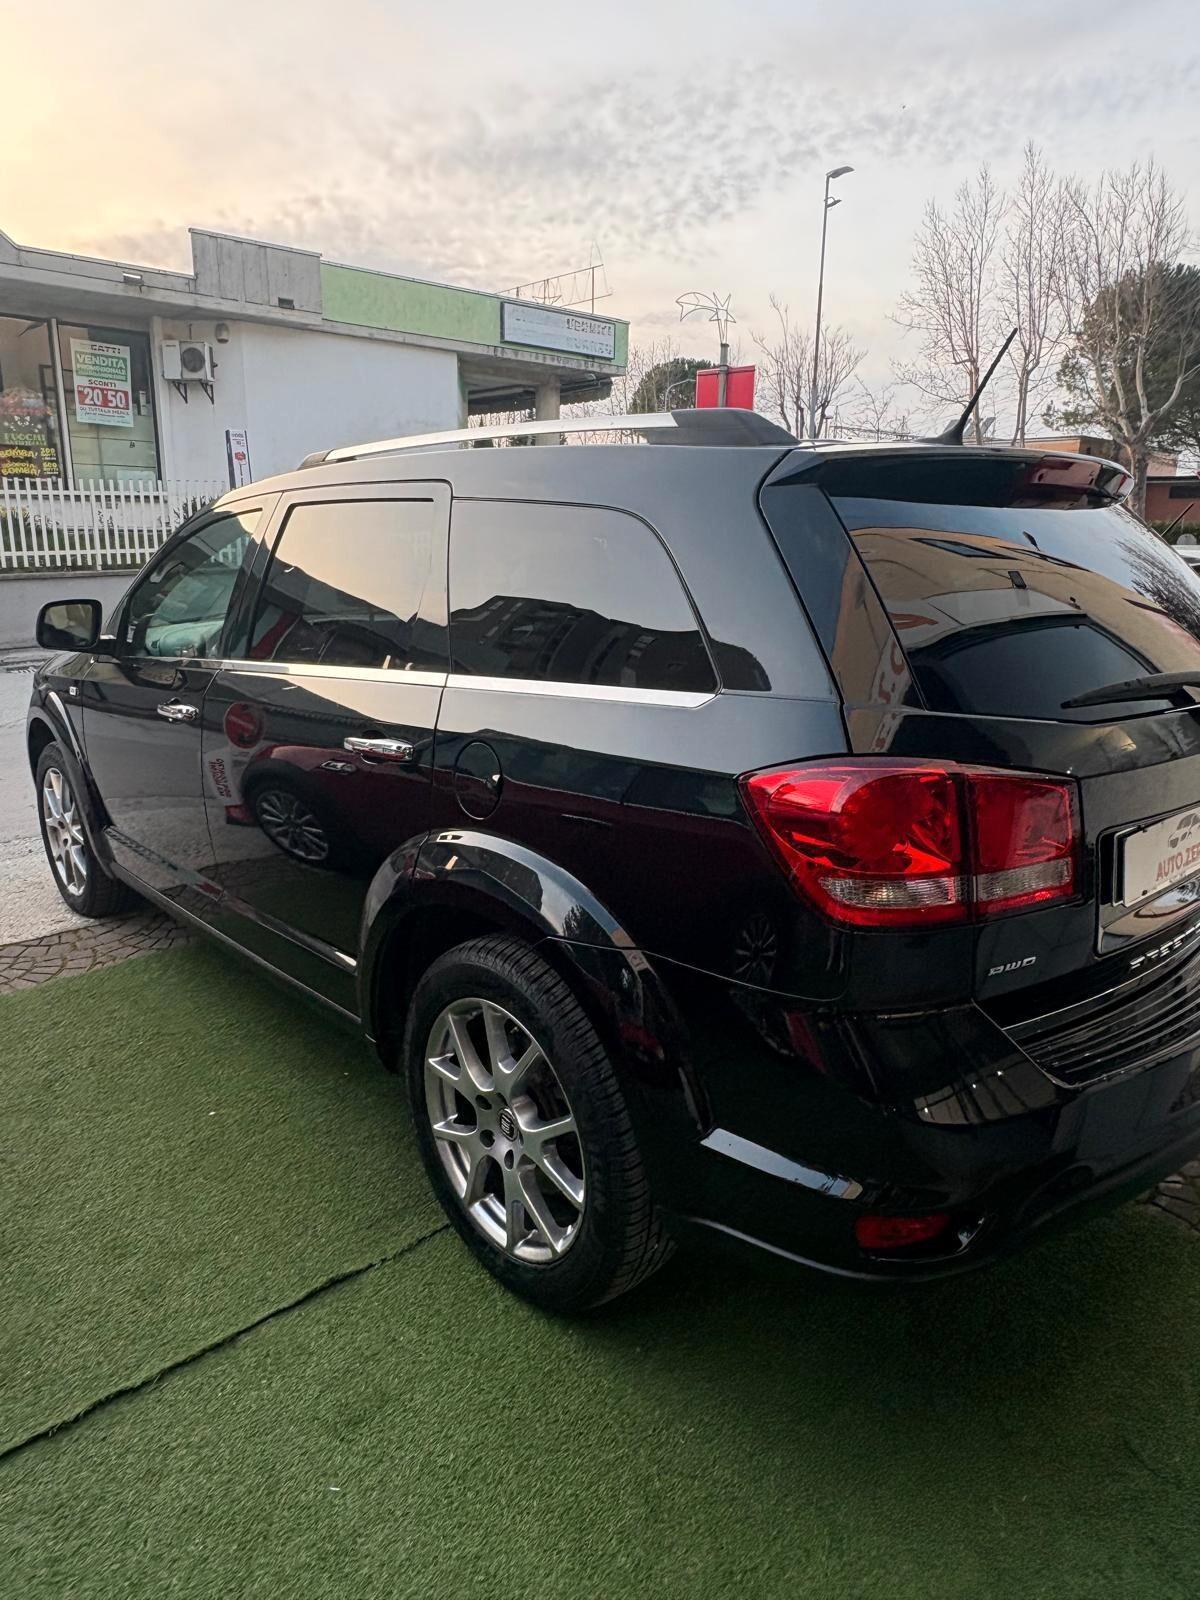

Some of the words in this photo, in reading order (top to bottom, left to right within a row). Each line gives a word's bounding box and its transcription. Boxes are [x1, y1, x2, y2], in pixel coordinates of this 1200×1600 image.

[76, 353, 126, 369] VENDITA
[88, 379, 117, 388] SCONTI
[83, 387, 103, 405] 20
[107, 391, 126, 409] 50
[1155, 852, 1184, 882] AUTO
